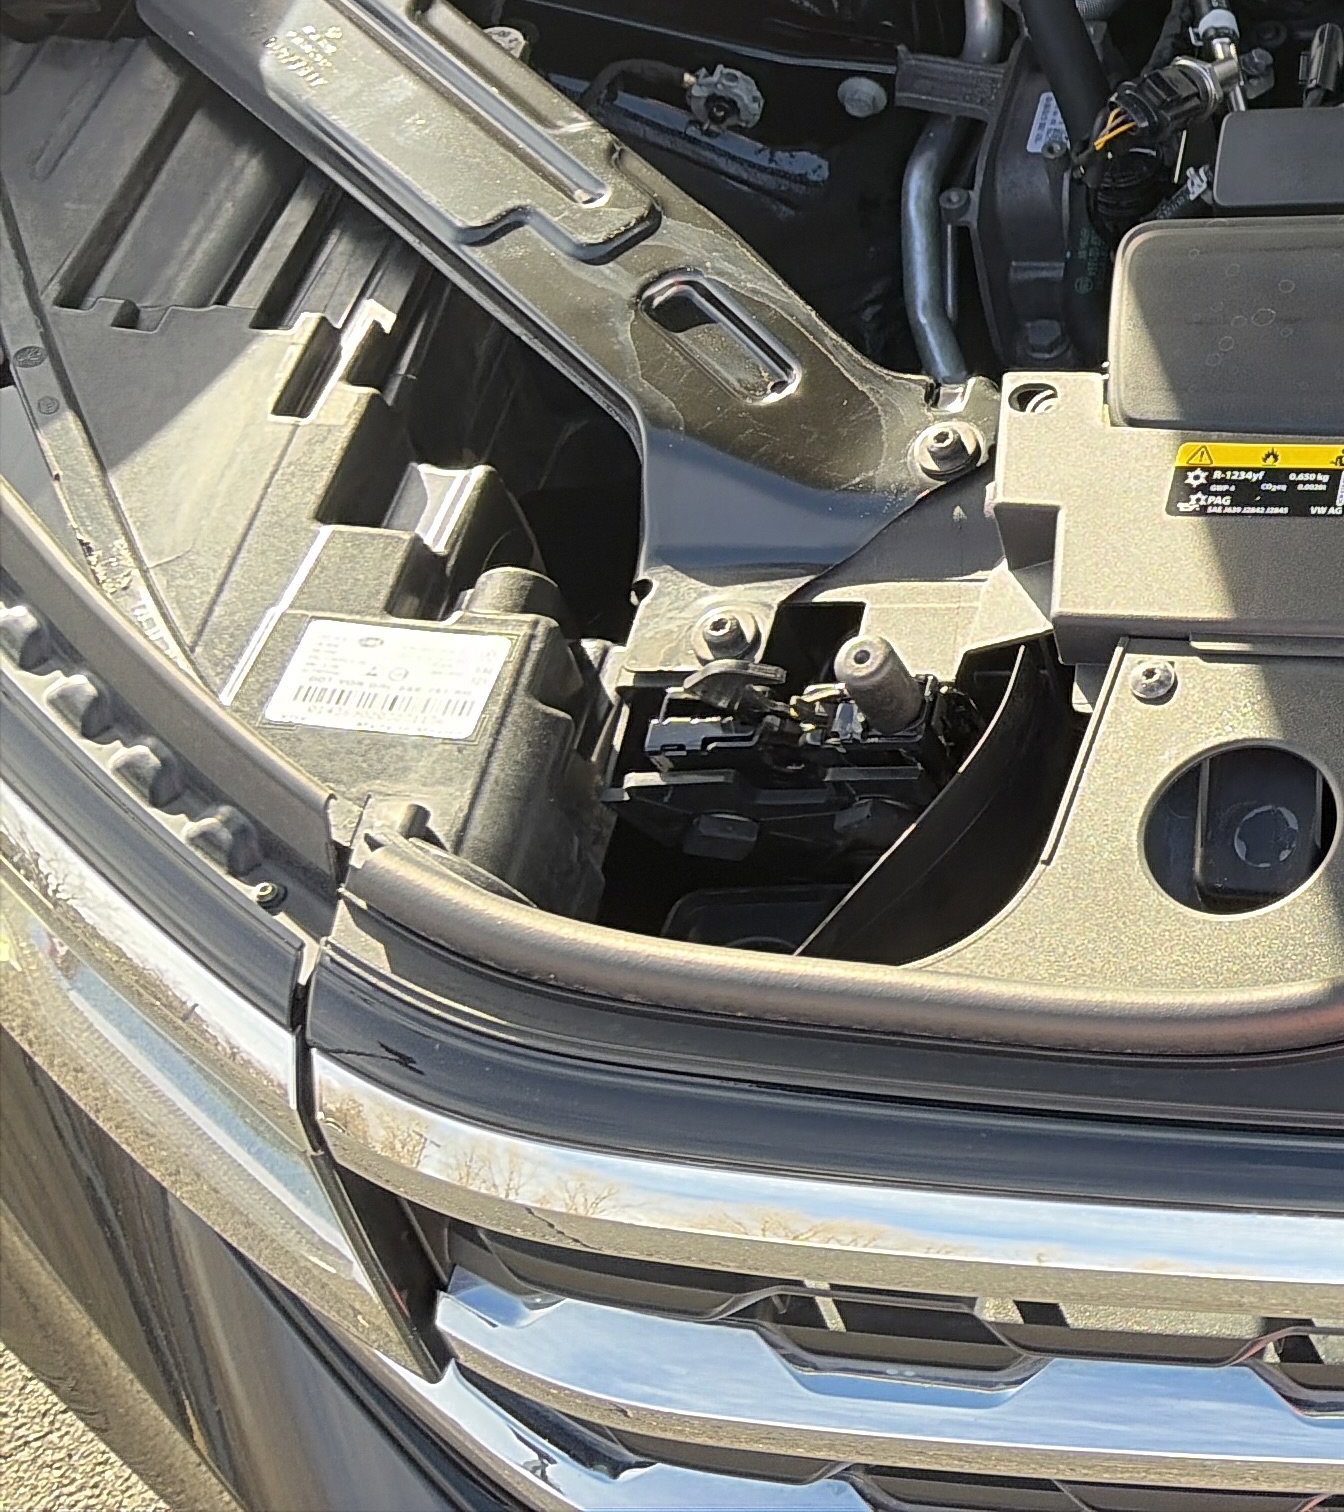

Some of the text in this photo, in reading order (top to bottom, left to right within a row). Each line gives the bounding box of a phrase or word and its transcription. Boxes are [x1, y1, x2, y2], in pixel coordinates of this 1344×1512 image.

[1212, 470, 1265, 483] R-1234yf
[1316, 472, 1330, 483] kg
[1206, 496, 1232, 505] PAG
[1310, 505, 1327, 515] VW
[1327, 506, 1343, 515] AG
